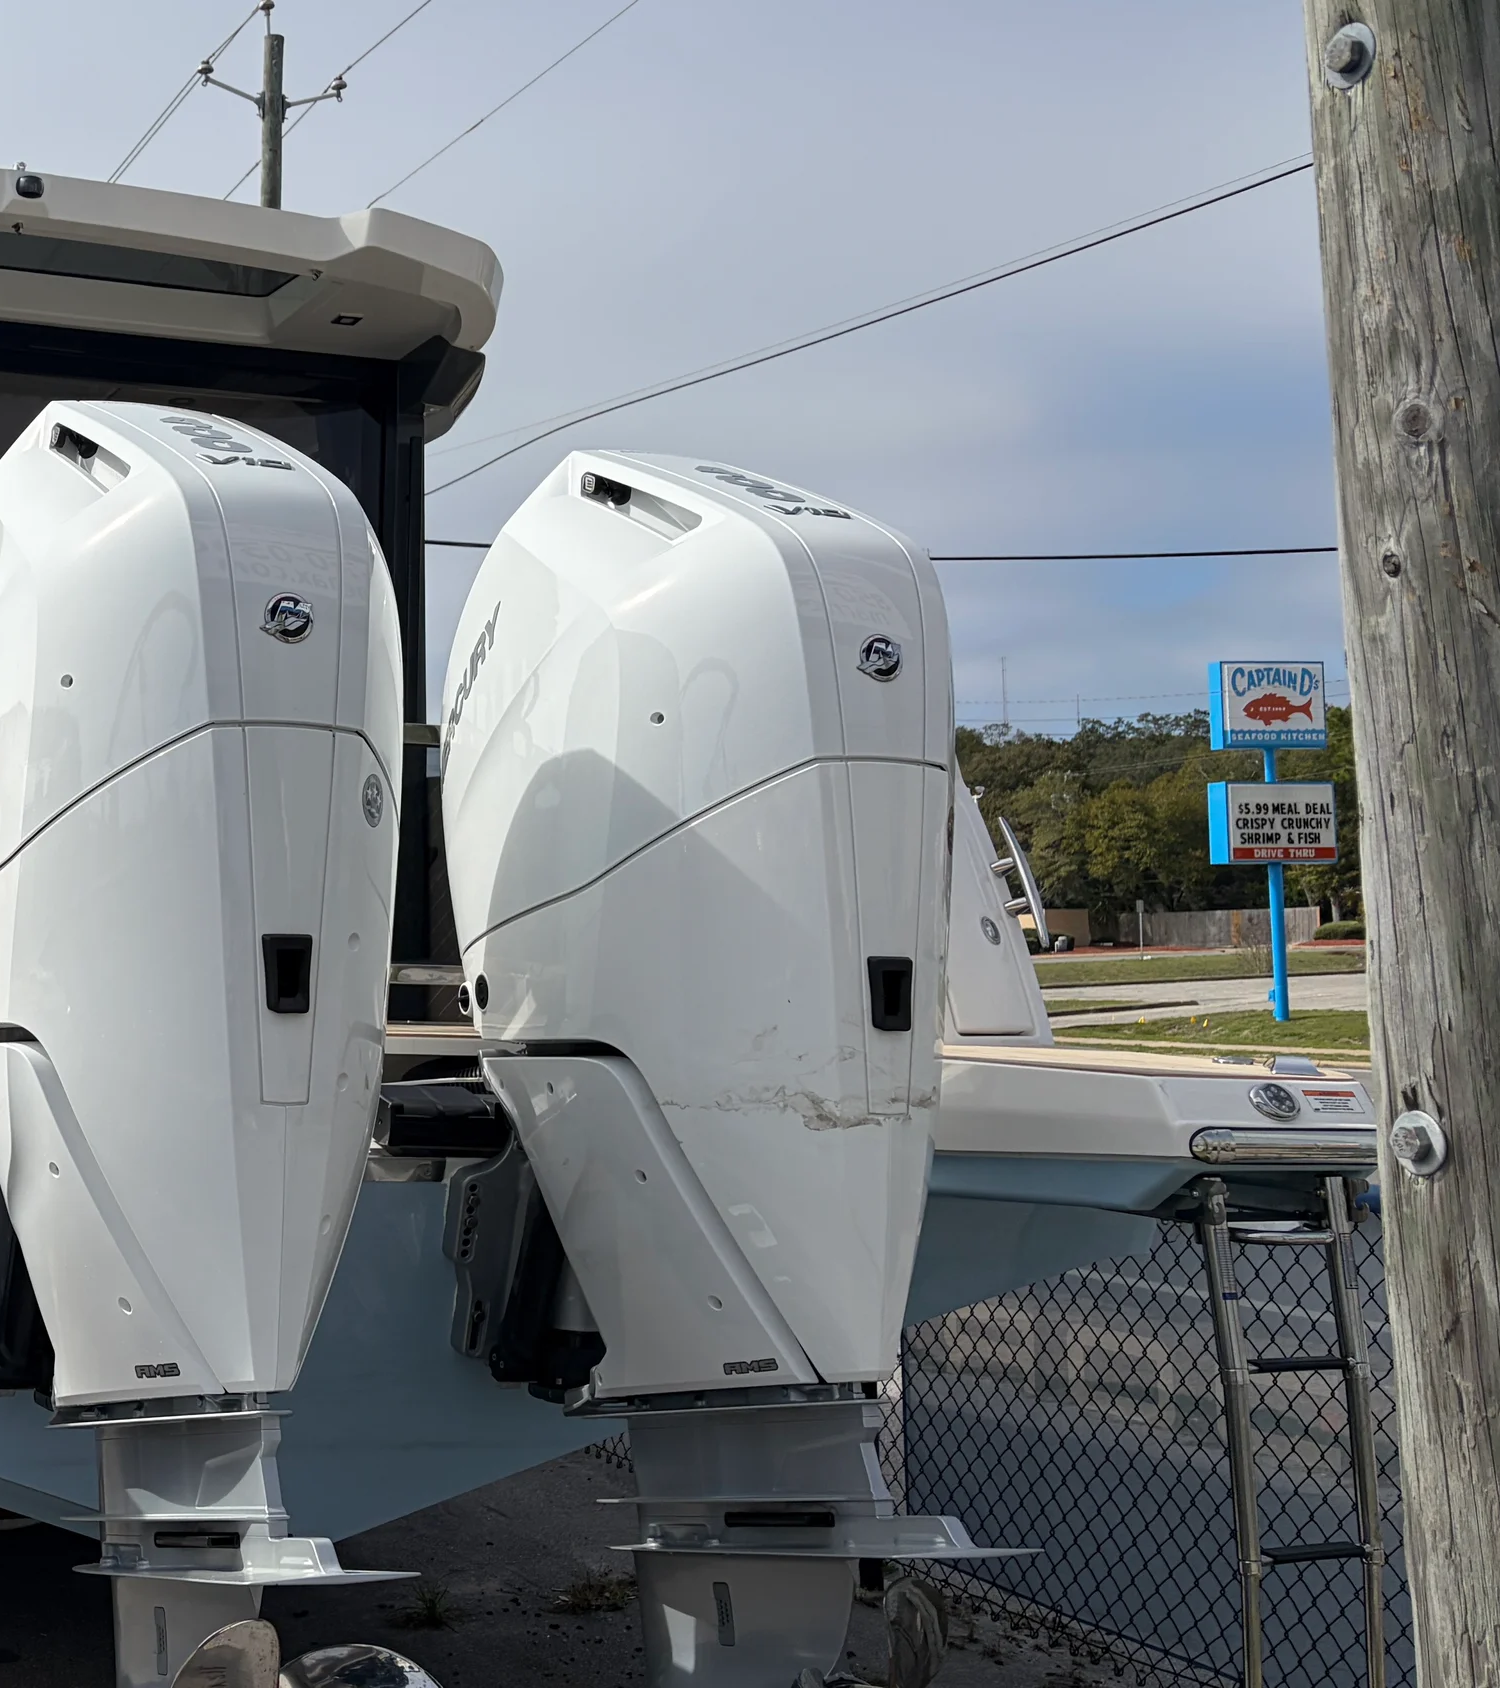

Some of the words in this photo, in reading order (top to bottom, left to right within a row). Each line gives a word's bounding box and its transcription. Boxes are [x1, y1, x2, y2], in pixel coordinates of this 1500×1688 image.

[1231, 733, 1277, 741] SEAFOOD
[1281, 733, 1325, 741] KITCHEN
[1238, 802, 1269, 815] $5.99
[1272, 802, 1300, 815] MEAL
[1305, 802, 1332, 815] DEAL
[1236, 817, 1275, 830] CRISPY
[1281, 817, 1331, 830] CRUNCHY
[1240, 832, 1281, 845] SHRIMP
[1287, 832, 1295, 845] &
[1298, 832, 1321, 845] FISH
[1254, 849, 1284, 858] DRIVE
[1289, 849, 1316, 858] THRU
[135, 1362, 181, 1379] AMS
